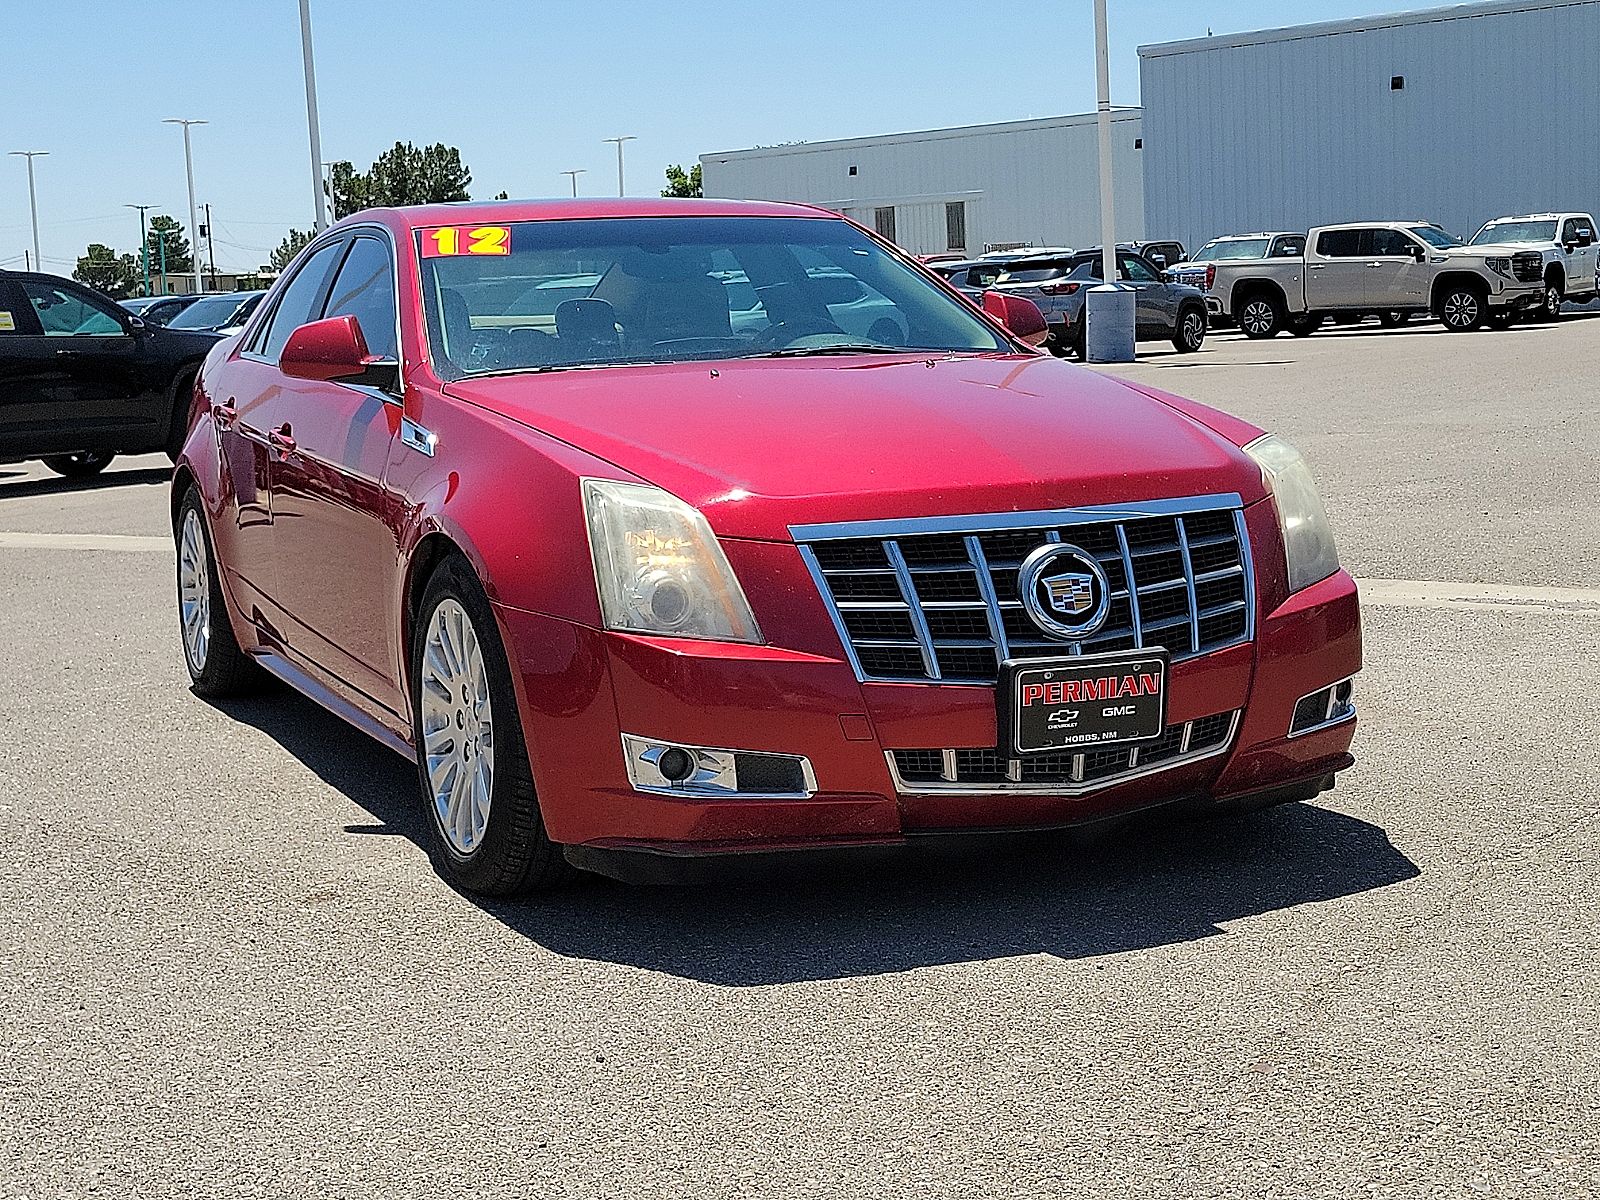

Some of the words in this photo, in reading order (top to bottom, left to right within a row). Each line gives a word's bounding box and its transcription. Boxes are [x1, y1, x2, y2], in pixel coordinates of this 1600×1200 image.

[430, 226, 509, 256] 12
[1022, 672, 1160, 707] PERMIAN
[1102, 705, 1136, 717] GMC
[1101, 730, 1117, 740] NM
